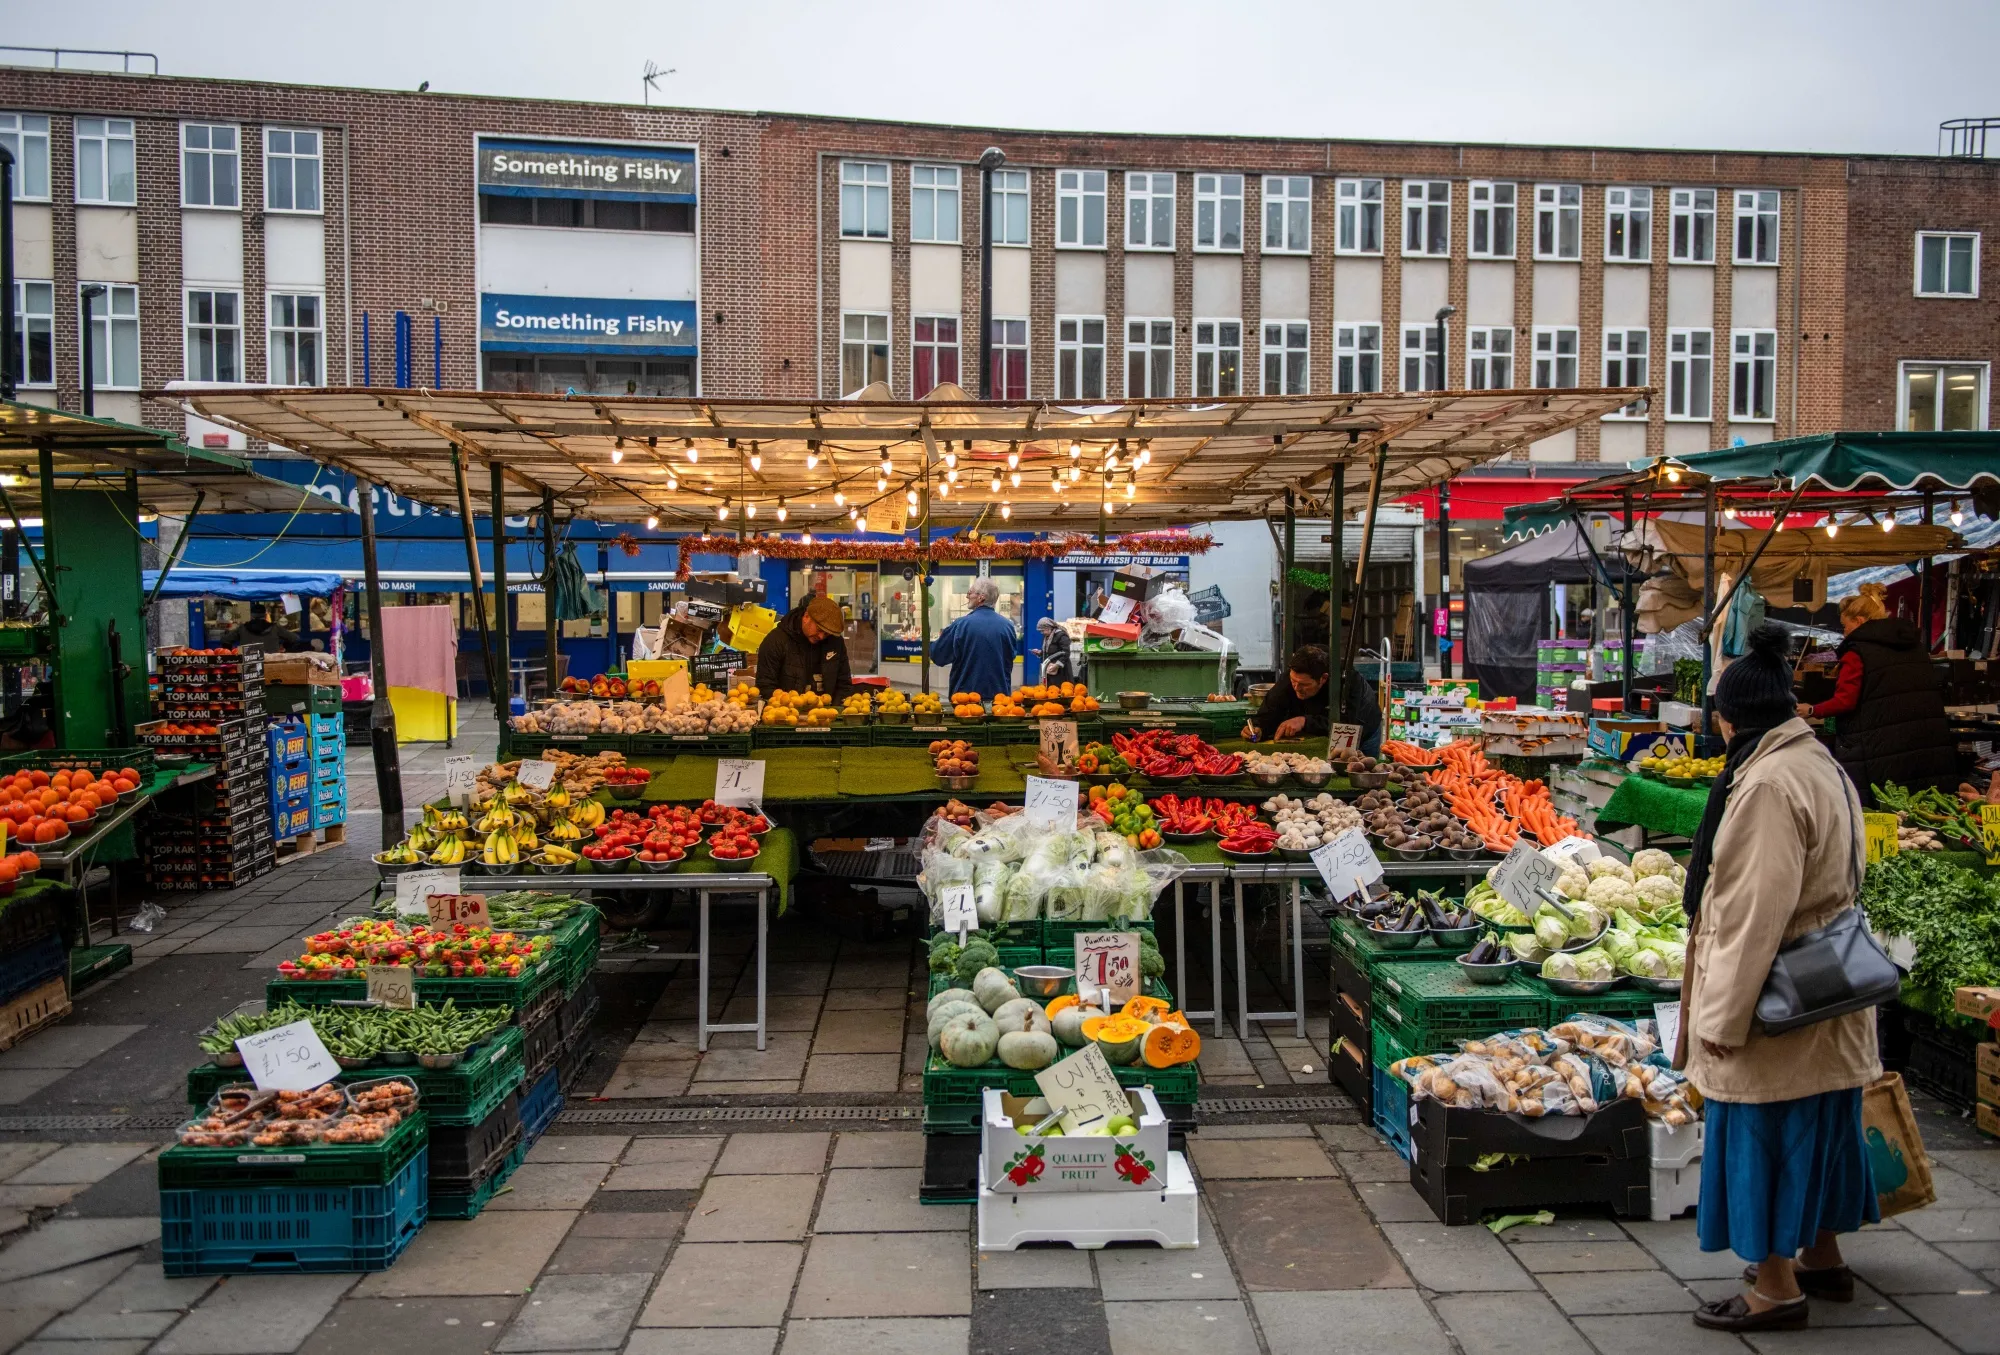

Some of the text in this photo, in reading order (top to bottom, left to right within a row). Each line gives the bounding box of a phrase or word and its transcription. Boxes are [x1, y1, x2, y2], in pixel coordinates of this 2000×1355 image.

[493, 155, 682, 184] Something Fishy
[495, 310, 684, 336] Something Fishy
[165, 655, 208, 664] TOP KAKI
[165, 674, 208, 683] TOP KAKI
[166, 692, 209, 701] TOP KAKI
[167, 710, 210, 720] TOP KAKI
[316, 722, 330, 734] Huskie
[143, 734, 186, 744] TOP KAKI
[318, 744, 332, 756] Huskie
[318, 767, 331, 778] Huskie
[318, 790, 332, 802] Huskie
[320, 811, 334, 823] Huskie
[1056, 1062, 1084, 1088] 3
[1052, 1153, 1106, 1164] QUALITY
[1062, 1170, 1098, 1179] FRUIT
